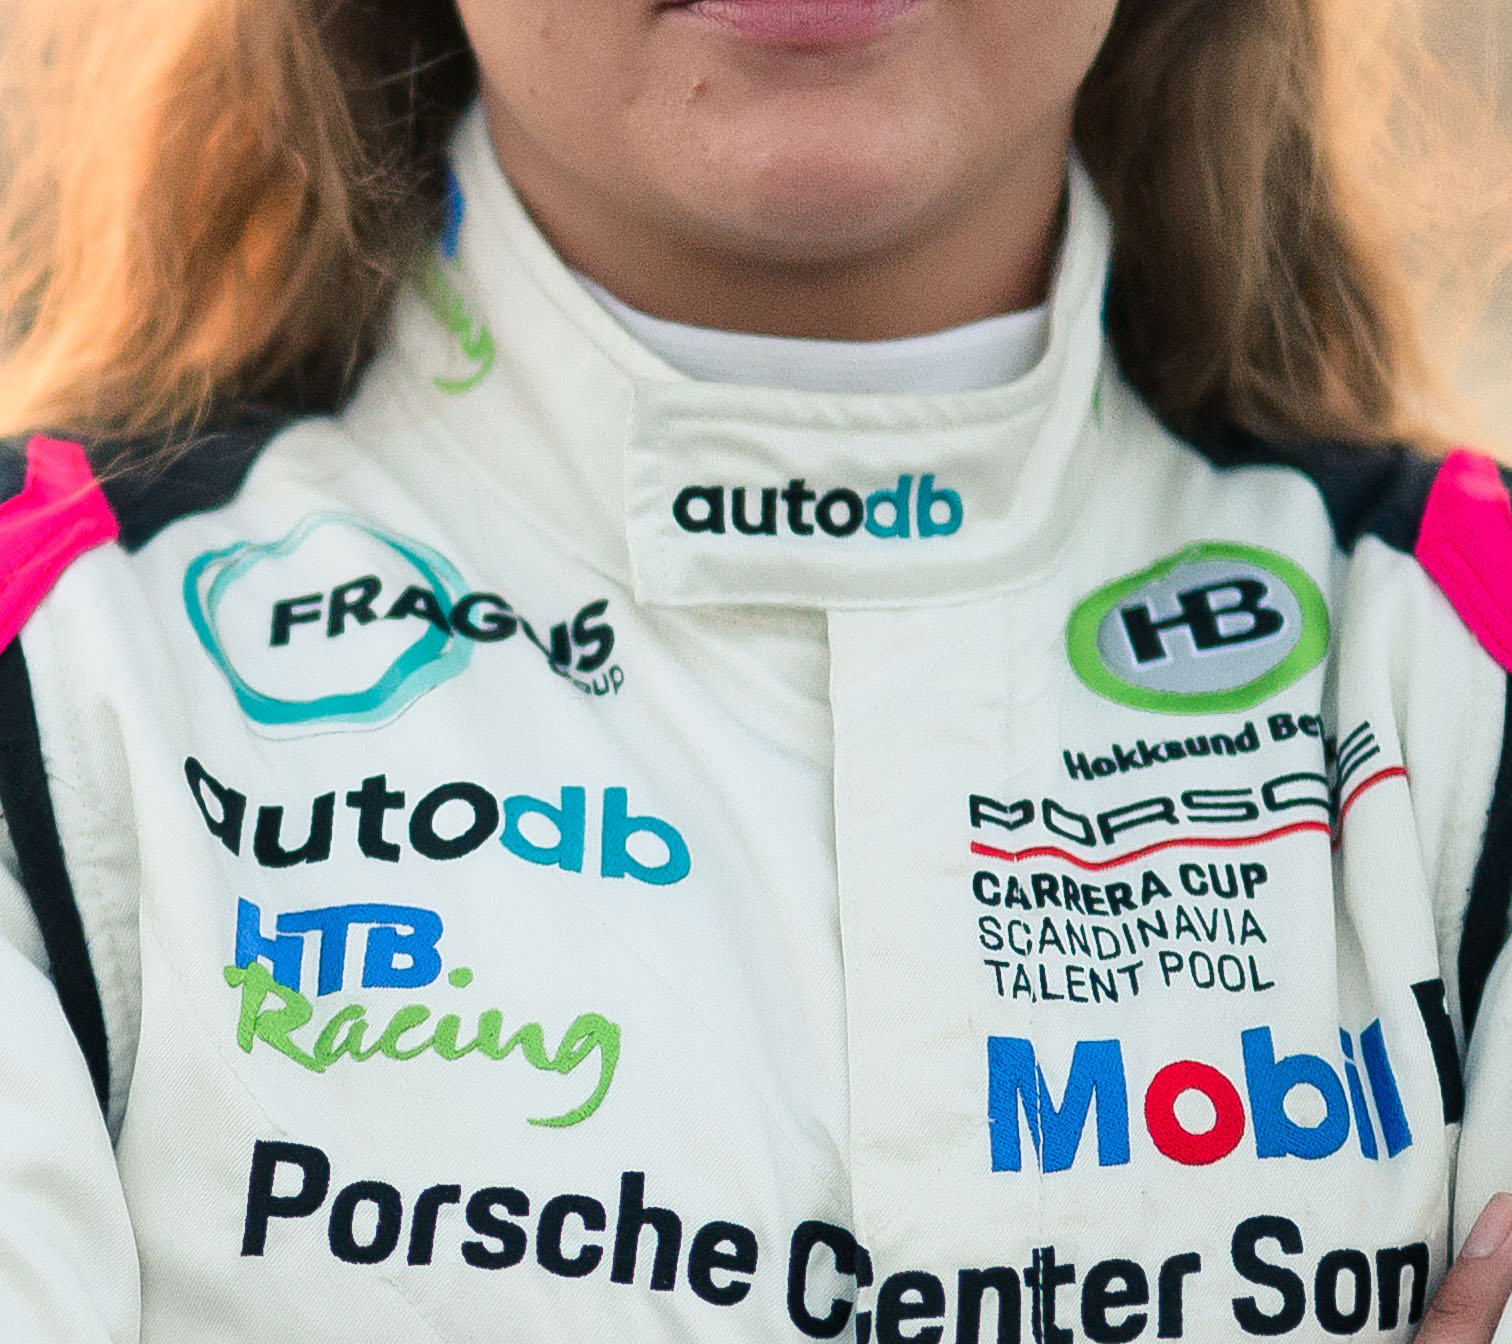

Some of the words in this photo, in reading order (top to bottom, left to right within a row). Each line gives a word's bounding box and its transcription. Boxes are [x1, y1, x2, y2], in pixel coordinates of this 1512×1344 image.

[671, 473, 965, 541] autodb
[268, 575, 616, 674] FRAGUS
[1120, 576, 1285, 666] HB
[968, 720, 1381, 847] PORSCE
[1062, 720, 1261, 781] Hokksund
[183, 756, 692, 886] autodb
[972, 869, 1172, 916] CARRERA
[1179, 862, 1268, 899] CUP
[978, 904, 1268, 961] SCANDINAVIA
[235, 896, 444, 997] HTB
[984, 959, 1144, 1004] TALENT
[1158, 950, 1275, 992] POOL
[223, 961, 621, 1128] Racing
[987, 1017, 1413, 1175] Mobil
[240, 1138, 760, 1308] Porsche
[1230, 1214, 1430, 1337] Son
